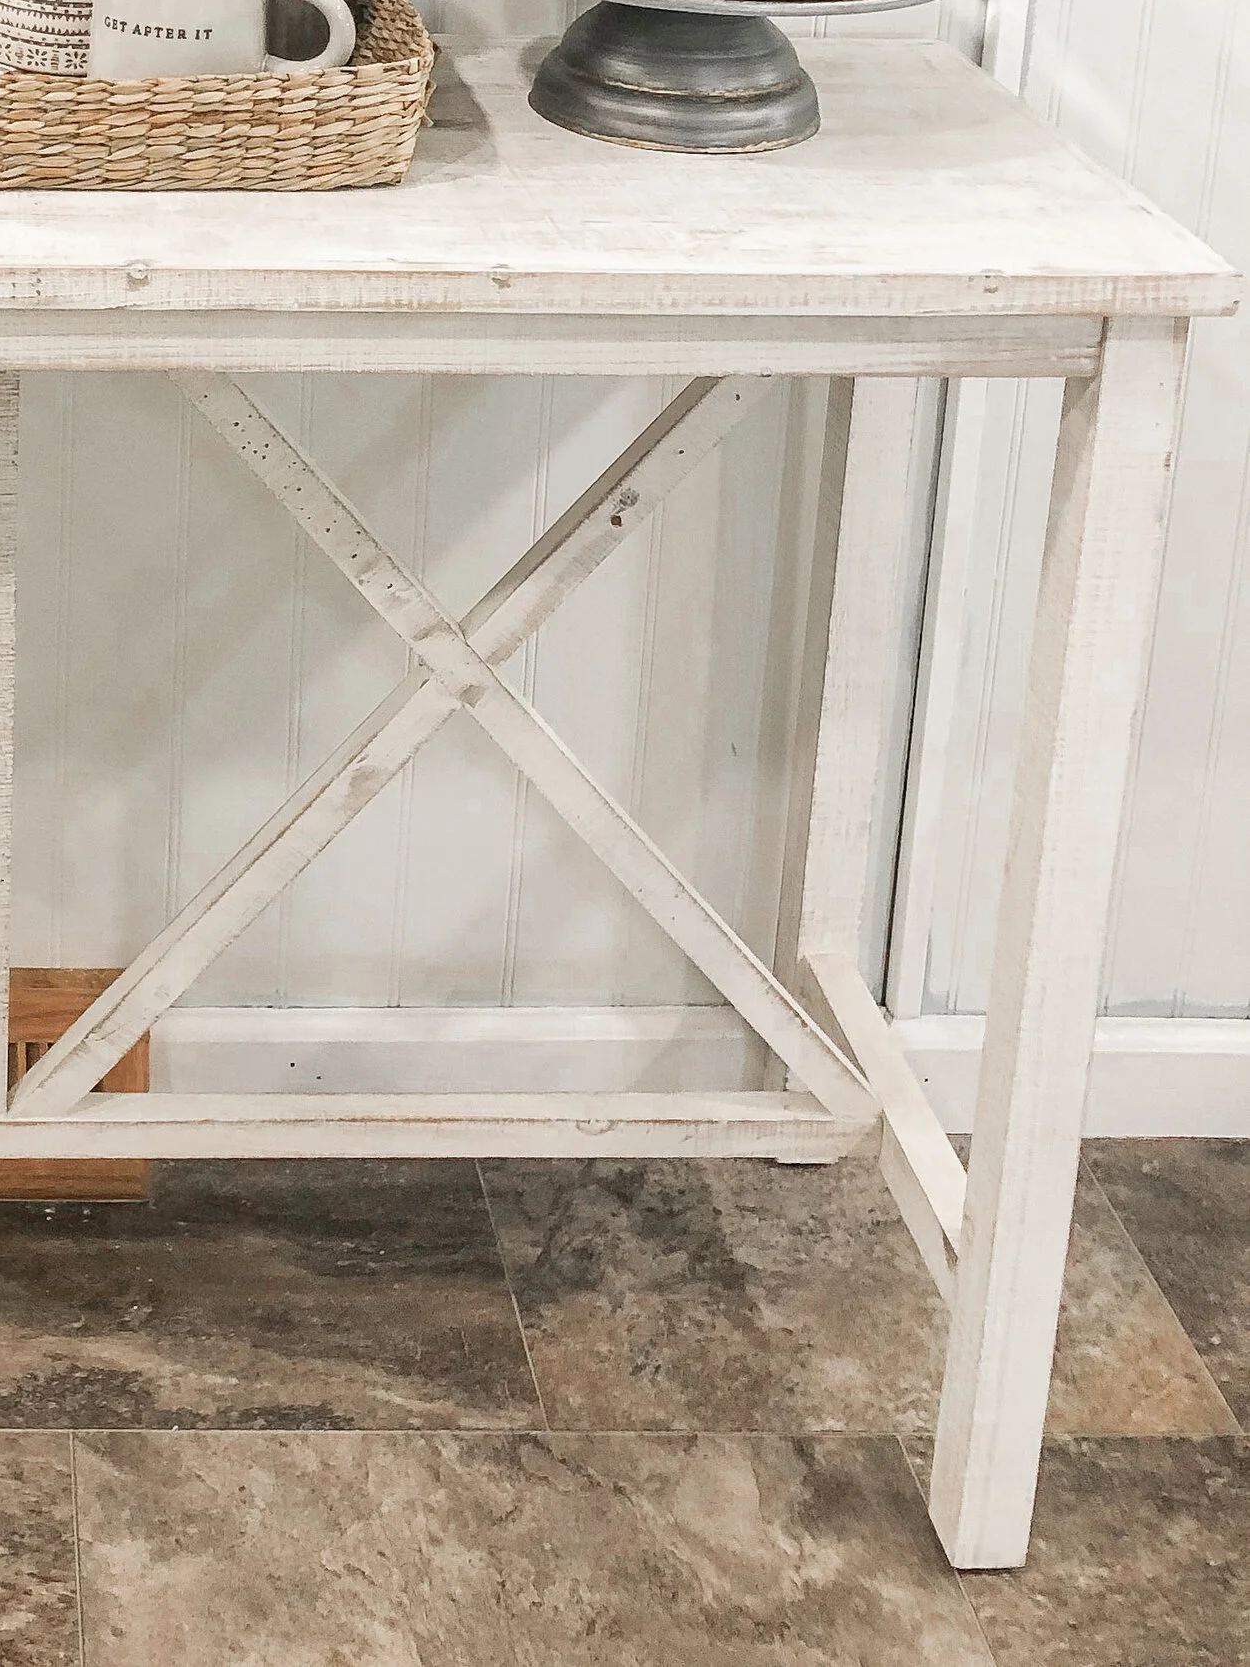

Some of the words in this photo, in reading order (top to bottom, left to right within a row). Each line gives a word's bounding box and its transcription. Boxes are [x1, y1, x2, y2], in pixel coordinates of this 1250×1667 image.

[104, 16, 128, 33] GET
[132, 24, 187, 40] AFTER
[194, 28, 213, 41] IT
